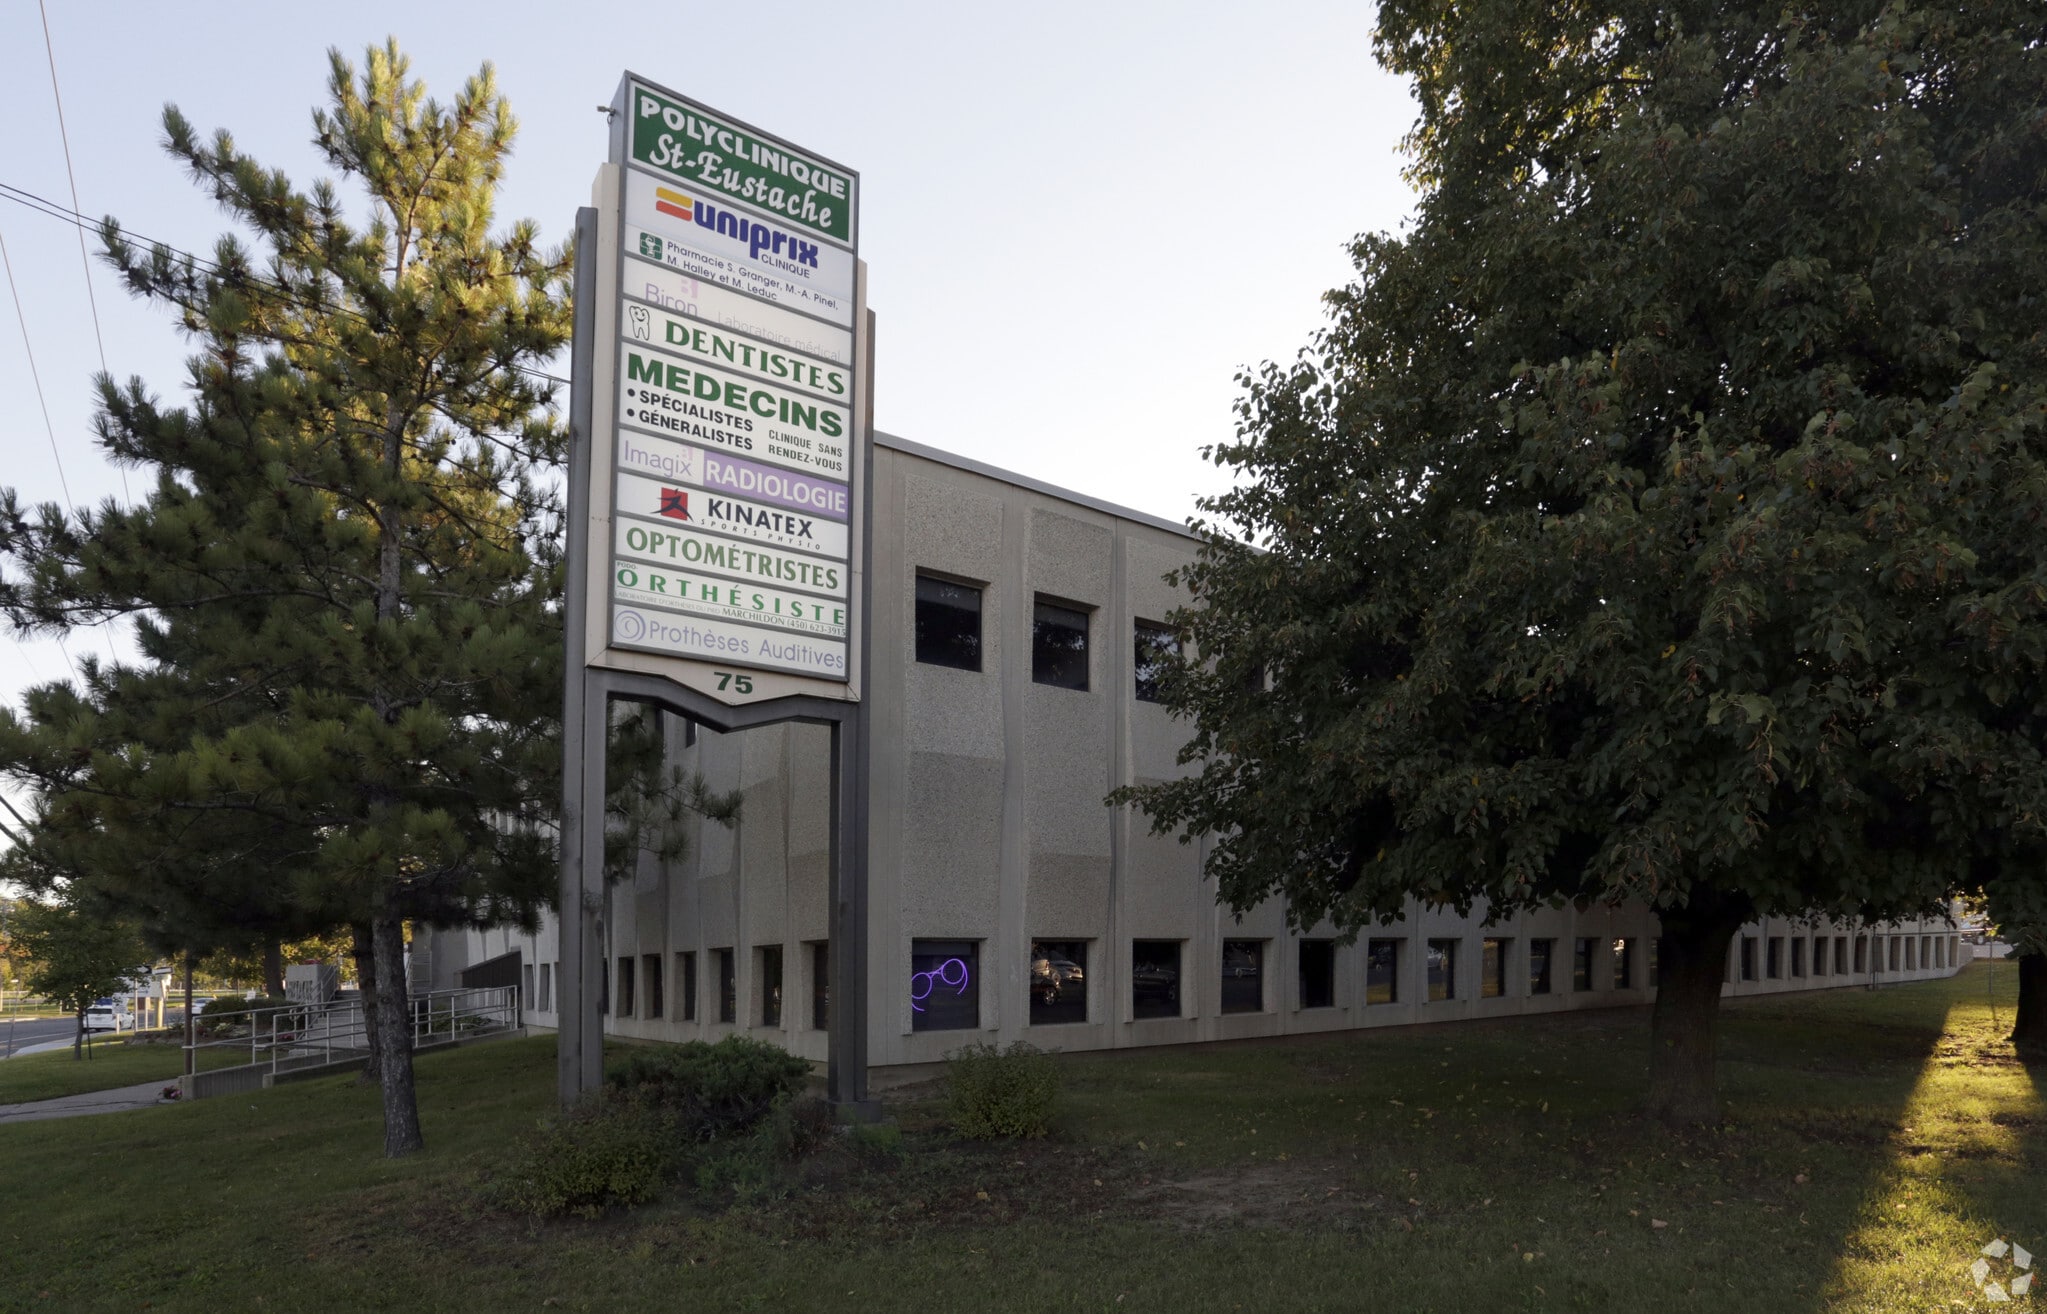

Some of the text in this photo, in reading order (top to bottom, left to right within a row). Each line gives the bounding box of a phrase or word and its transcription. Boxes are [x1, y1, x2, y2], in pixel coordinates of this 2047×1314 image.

[640, 95, 846, 200] POLYCLINIQUE
[649, 134, 832, 228] St-Eustache
[693, 200, 818, 269] uniprix
[667, 241, 839, 310] Pharmacie S. Granger, M.-A. Pinel,
[667, 254, 777, 300] M. Halley et M. Leduc
[761, 254, 810, 279] CLINIQUE
[645, 282, 841, 363] Biron Laboratoire médical
[665, 320, 845, 395] DENTISTES
[628, 352, 843, 437] MEDECINS
[639, 389, 753, 432] SPÉCIALISTES
[768, 429, 843, 458] CLINIQUE SANS
[768, 444, 842, 472] RENDEZ-VOUS
[625, 440, 846, 513] Imagix RADIOLOGIE
[700, 518, 821, 551] SPORTS PHYSIO
[708, 498, 813, 540] KINATEX
[626, 527, 838, 590] OPTOMÉTRISTES
[617, 569, 845, 626] ORTHÉSISTE
[722, 607, 785, 626] MARCHILDON
[787, 618, 808, 630] (450)
[650, 620, 844, 669] Prothèses Auditives
[713, 671, 753, 695] 75
